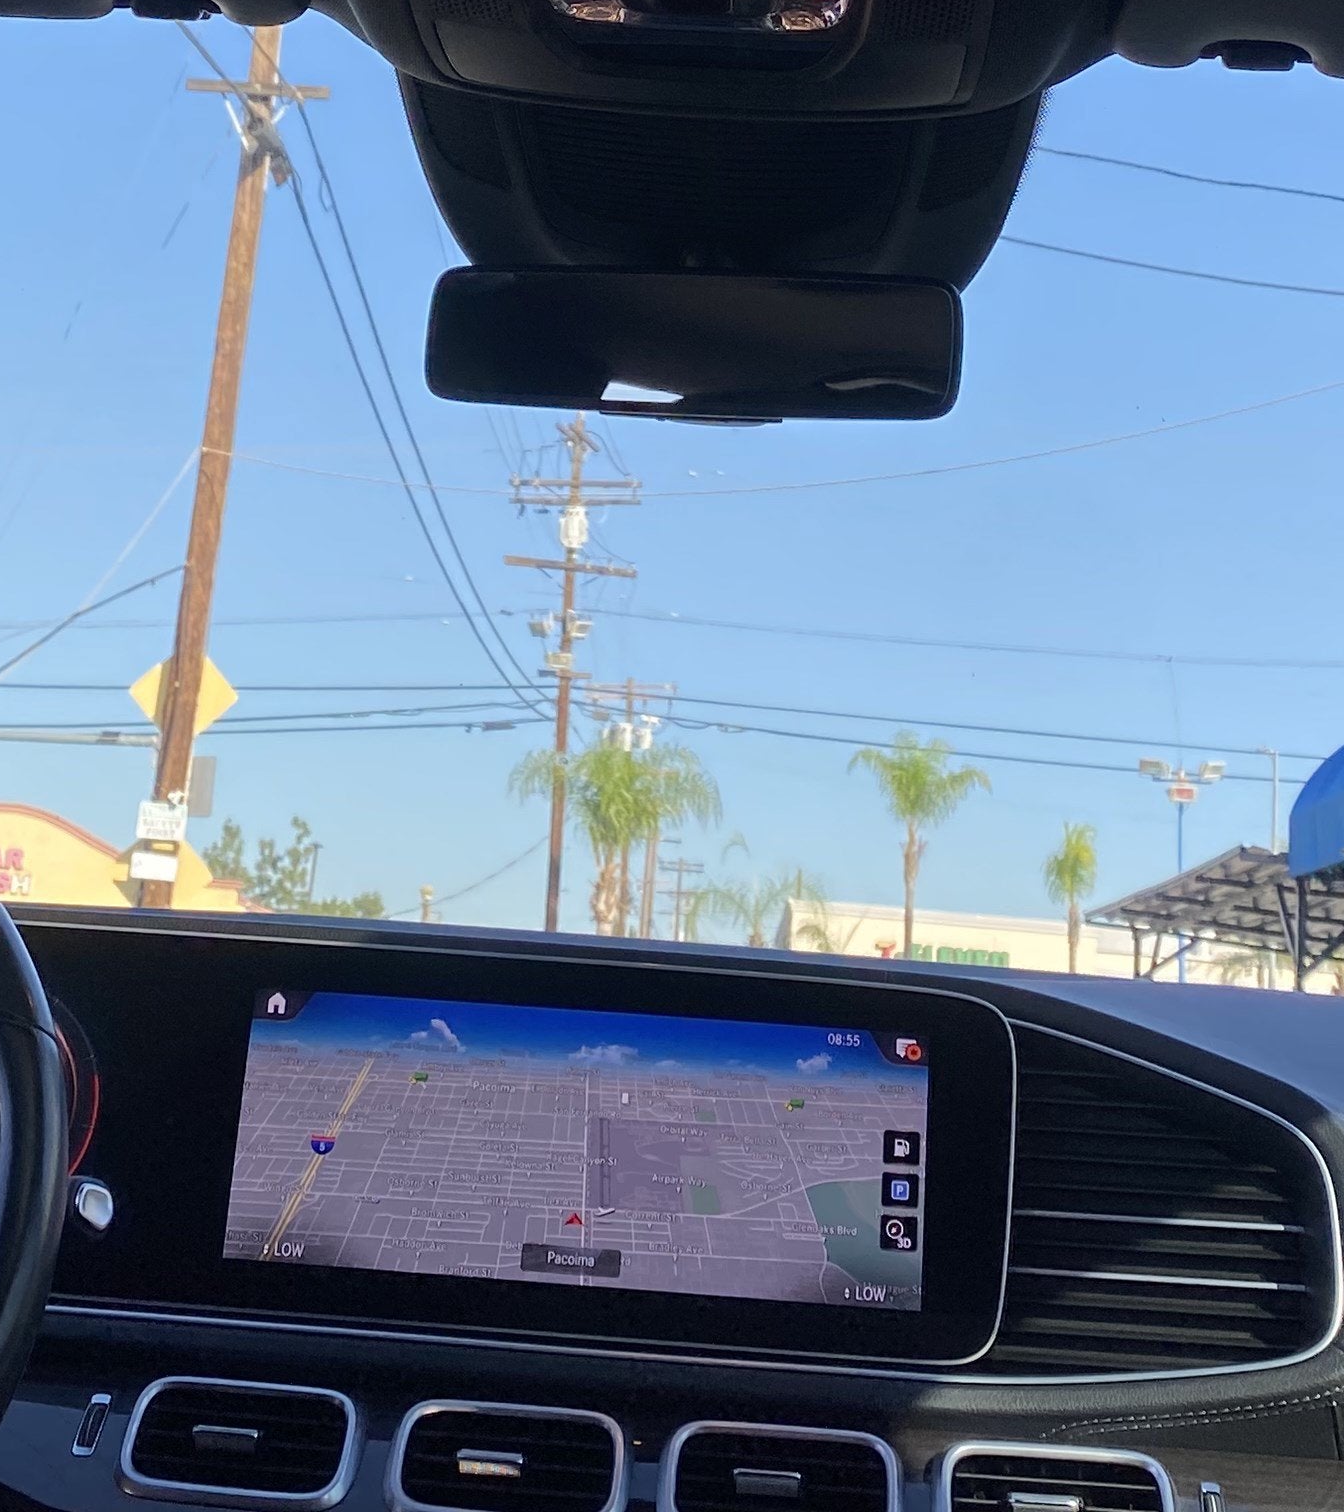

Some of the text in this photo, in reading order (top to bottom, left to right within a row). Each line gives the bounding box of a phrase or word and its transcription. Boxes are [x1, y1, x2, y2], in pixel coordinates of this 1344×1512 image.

[827, 1032, 861, 1047] 08:55
[472, 1080, 516, 1094] Pacoima
[659, 1124, 708, 1137] Orbital Way
[318, 1140, 326, 1152] 5
[545, 1161, 556, 1172] St
[607, 1157, 618, 1167] St
[427, 1179, 438, 1189] St
[491, 1174, 502, 1185] St
[651, 1173, 707, 1188] Airpark Way
[410, 1206, 470, 1220] Bromwich St
[666, 1213, 677, 1223] St
[252, 1230, 264, 1242] St
[837, 1225, 858, 1237] Blvd
[647, 1242, 704, 1256] Bradley Ave
[897, 1238, 912, 1249] 3D
[274, 1242, 305, 1258] LOW
[546, 1250, 596, 1268] Pacoima
[480, 1267, 492, 1278] St
[855, 1285, 887, 1303] LOW
